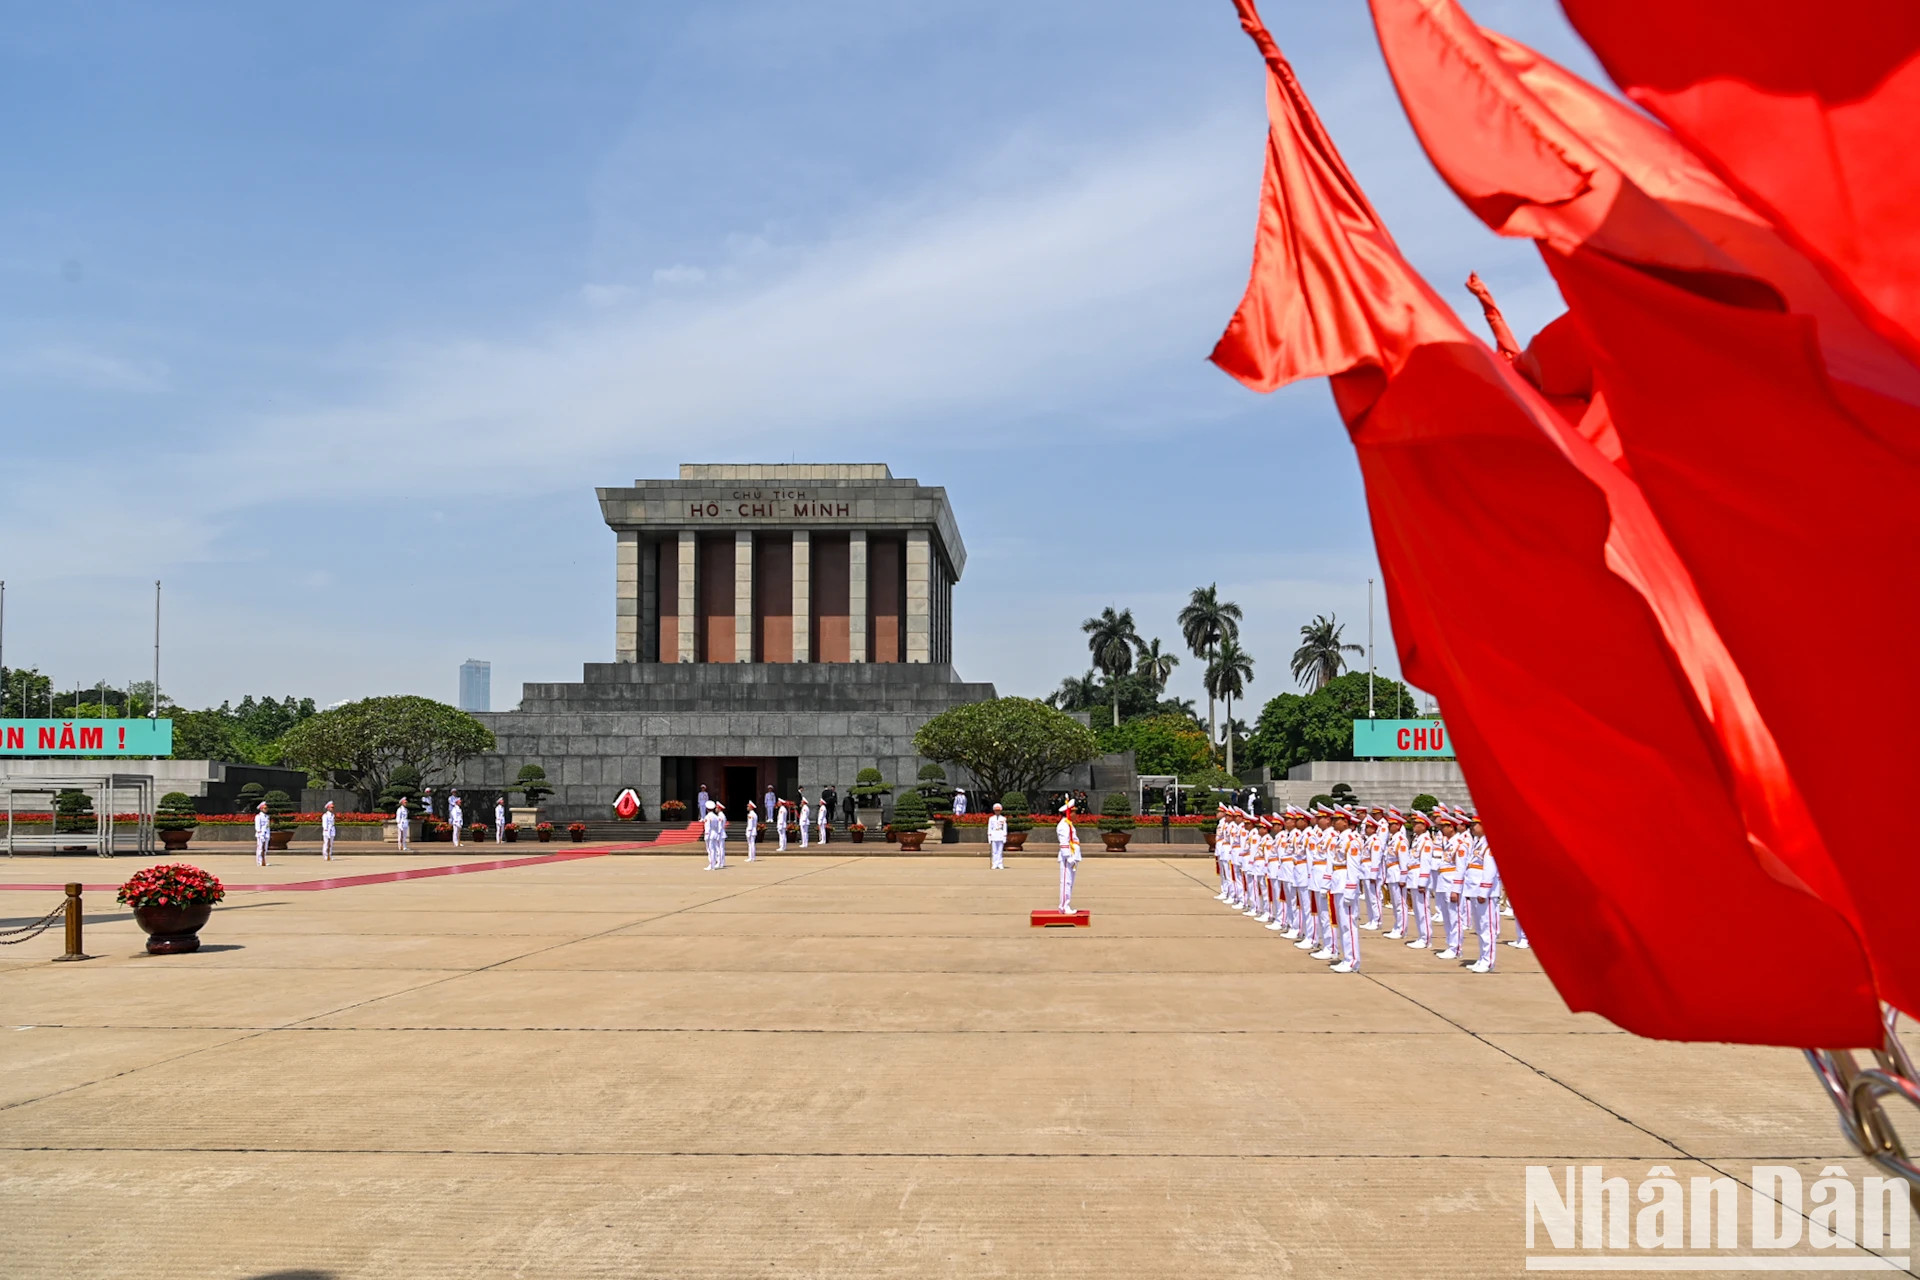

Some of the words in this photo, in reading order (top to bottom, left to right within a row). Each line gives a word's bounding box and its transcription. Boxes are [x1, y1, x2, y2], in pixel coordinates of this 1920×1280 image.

[0, 726, 24, 749] N
[38, 722, 103, 749] NĂM
[1397, 721, 1444, 751] CHỦ
